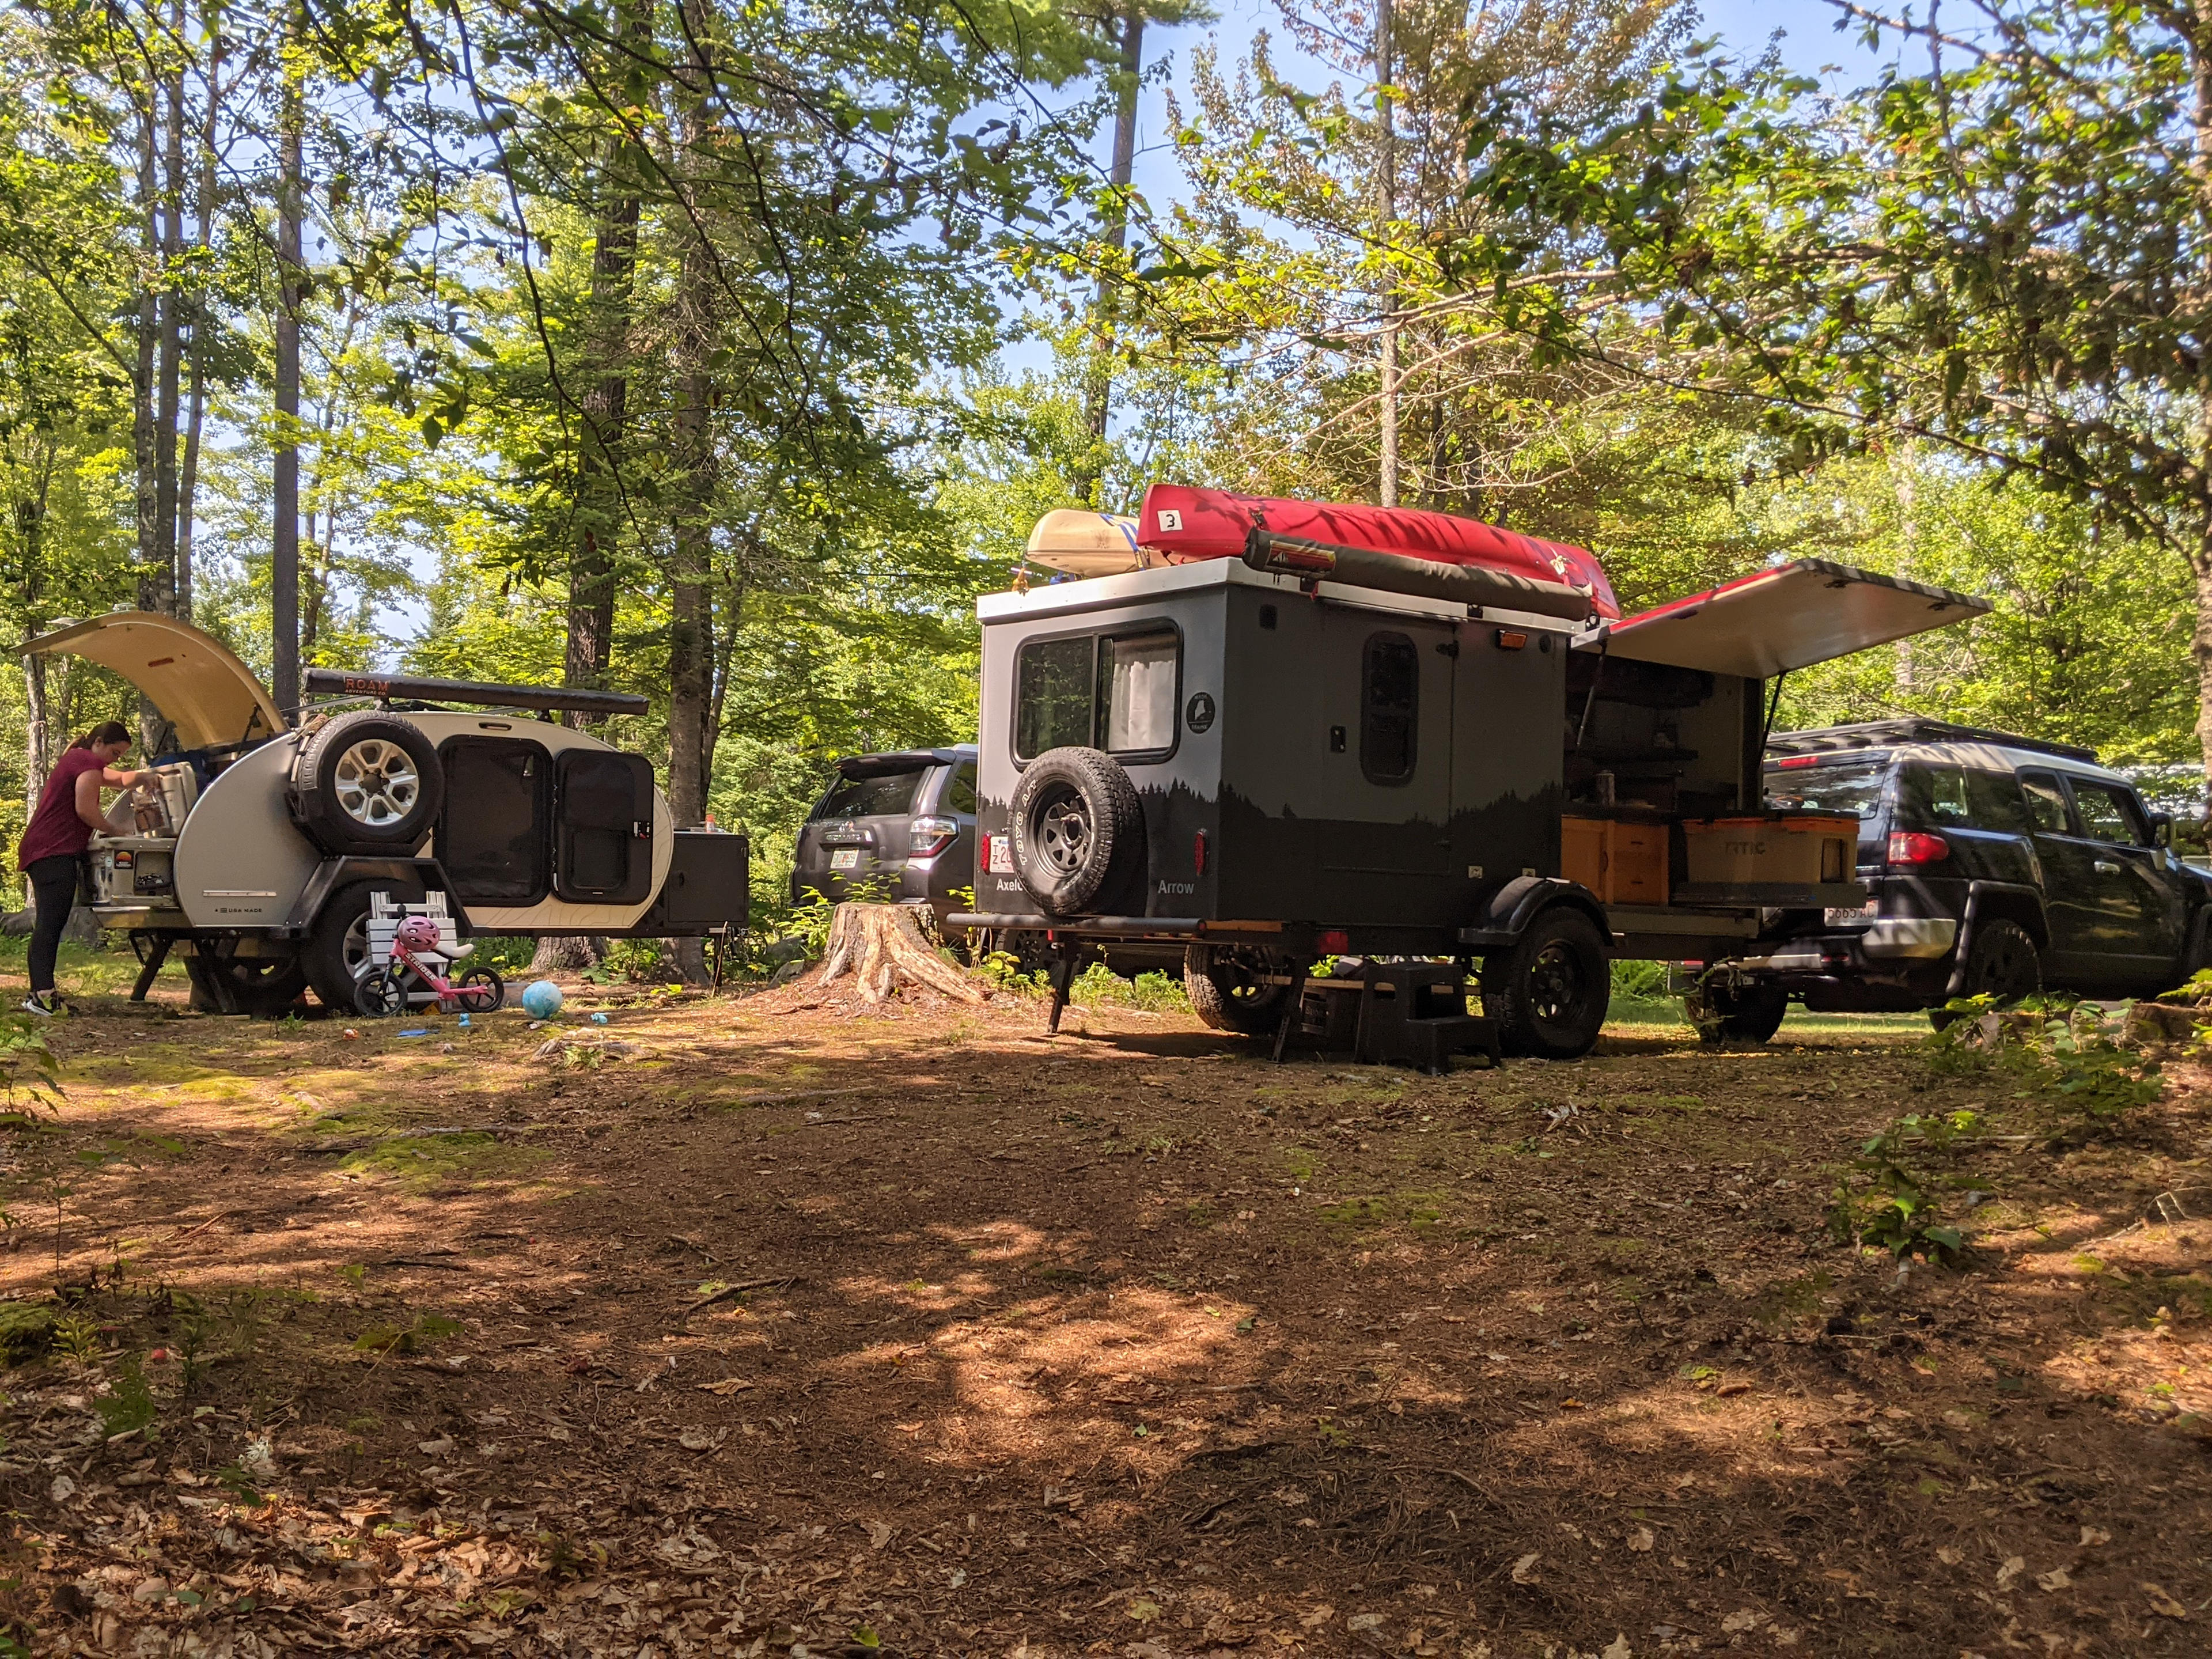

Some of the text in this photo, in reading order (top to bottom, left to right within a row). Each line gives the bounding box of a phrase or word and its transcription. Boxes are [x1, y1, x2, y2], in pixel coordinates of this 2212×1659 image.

[1166, 514, 1175, 528] 3
[346, 678, 389, 691] ROAM
[1016, 812, 1027, 865] TOYO
[1157, 880, 1194, 894] Arrow
[405, 952, 436, 981] STRIDER
